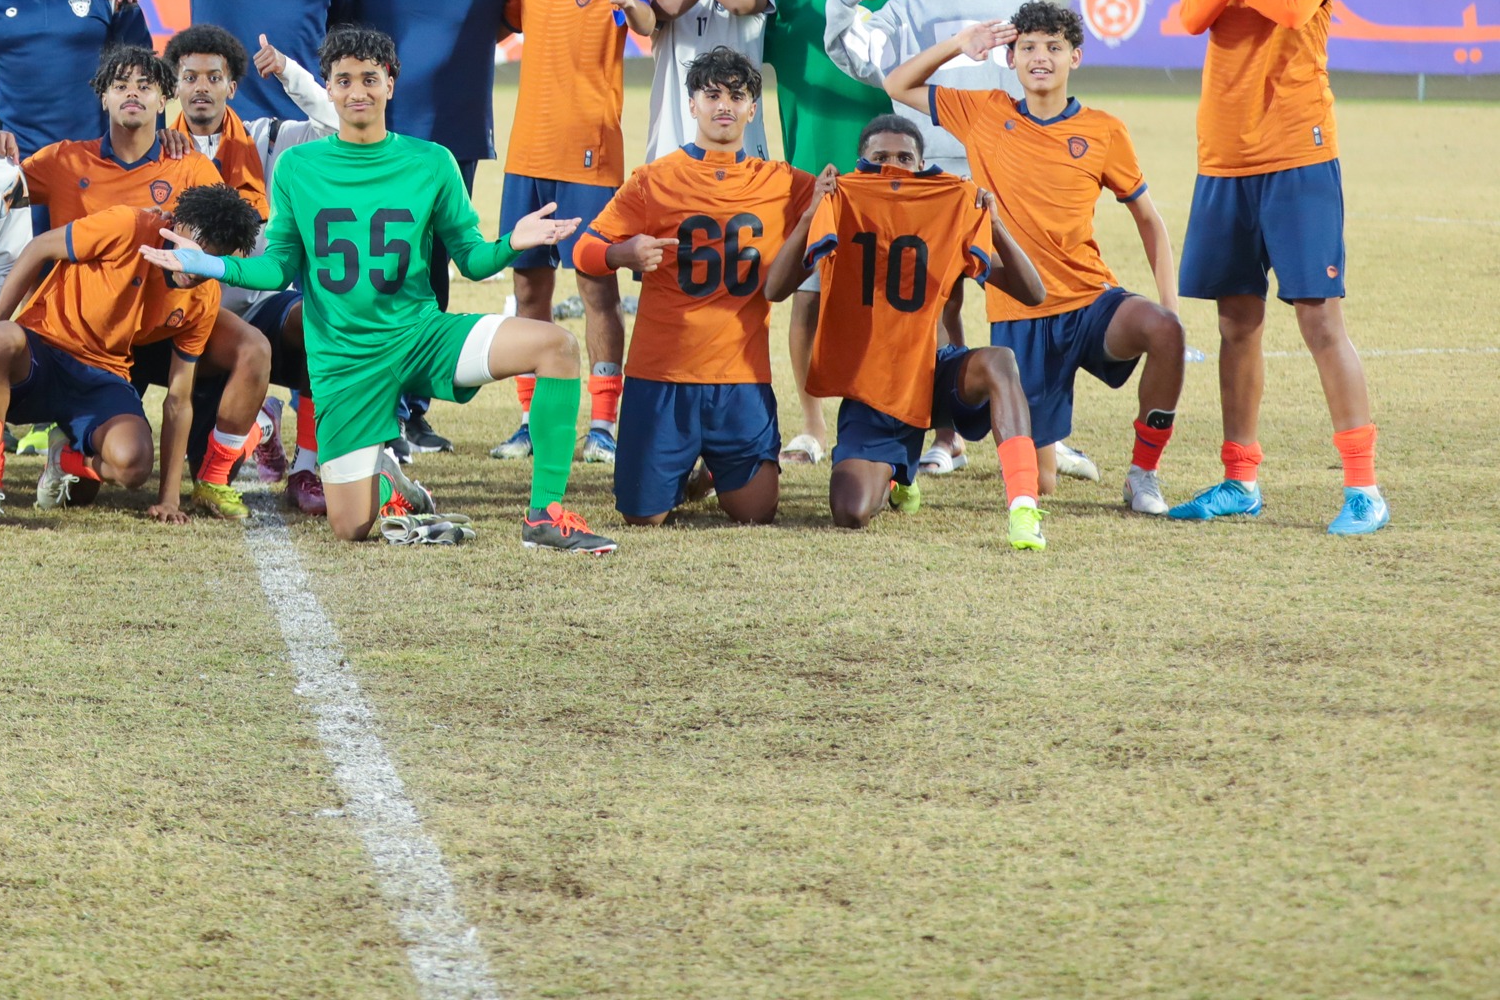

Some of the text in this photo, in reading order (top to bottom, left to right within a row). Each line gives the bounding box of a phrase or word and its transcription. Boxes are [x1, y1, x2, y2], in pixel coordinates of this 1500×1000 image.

[313, 207, 415, 295] 55
[677, 212, 763, 298] 66
[851, 231, 929, 313] 10
